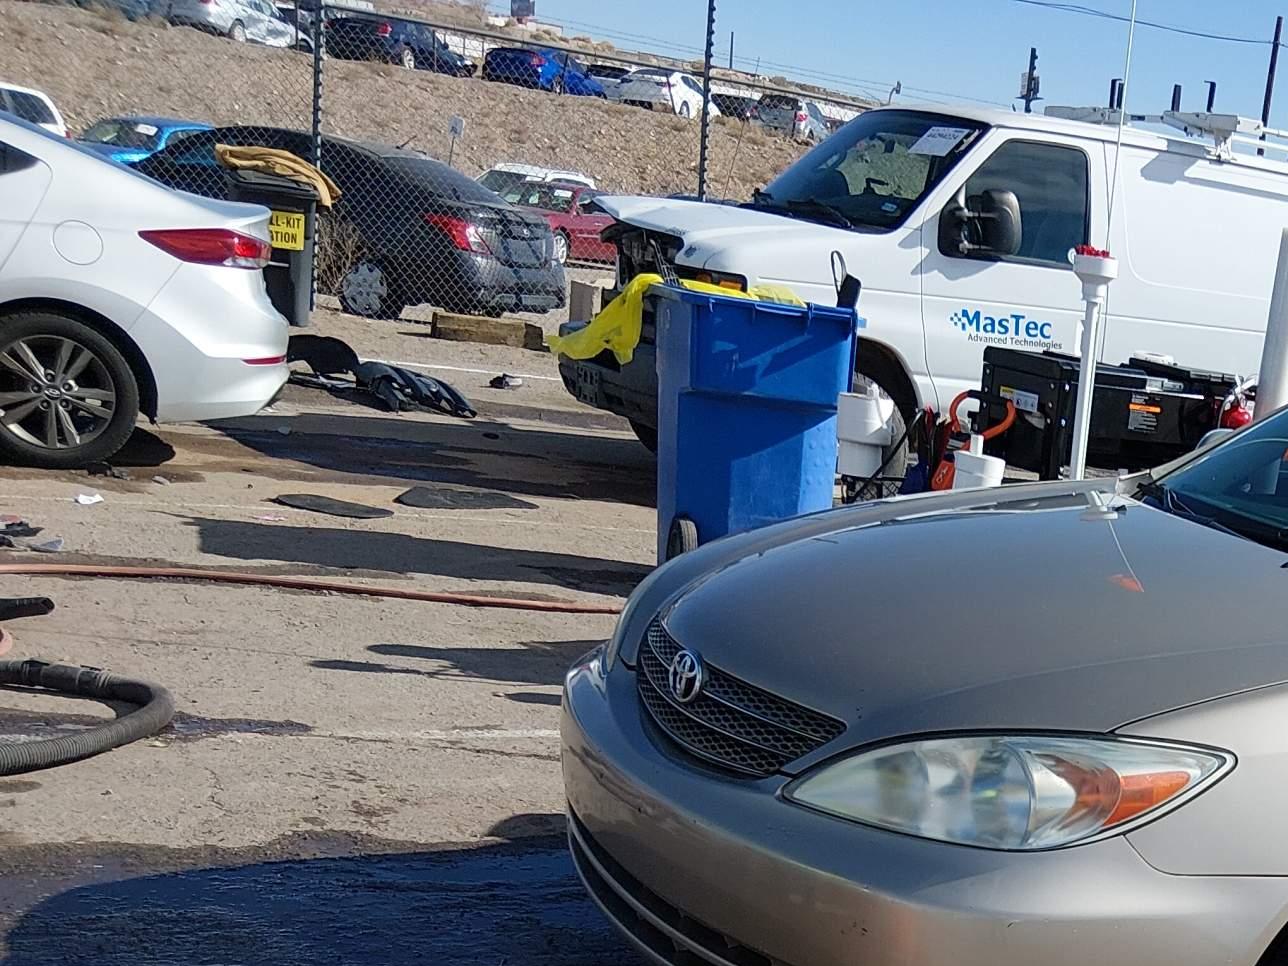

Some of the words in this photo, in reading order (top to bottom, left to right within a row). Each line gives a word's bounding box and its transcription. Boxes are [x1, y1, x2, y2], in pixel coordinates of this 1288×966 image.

[270, 215, 302, 230] LL-KIT
[961, 308, 1052, 339] MasTec
[968, 333, 1008, 345] Advanced
[1010, 337, 1063, 350] Technologies
